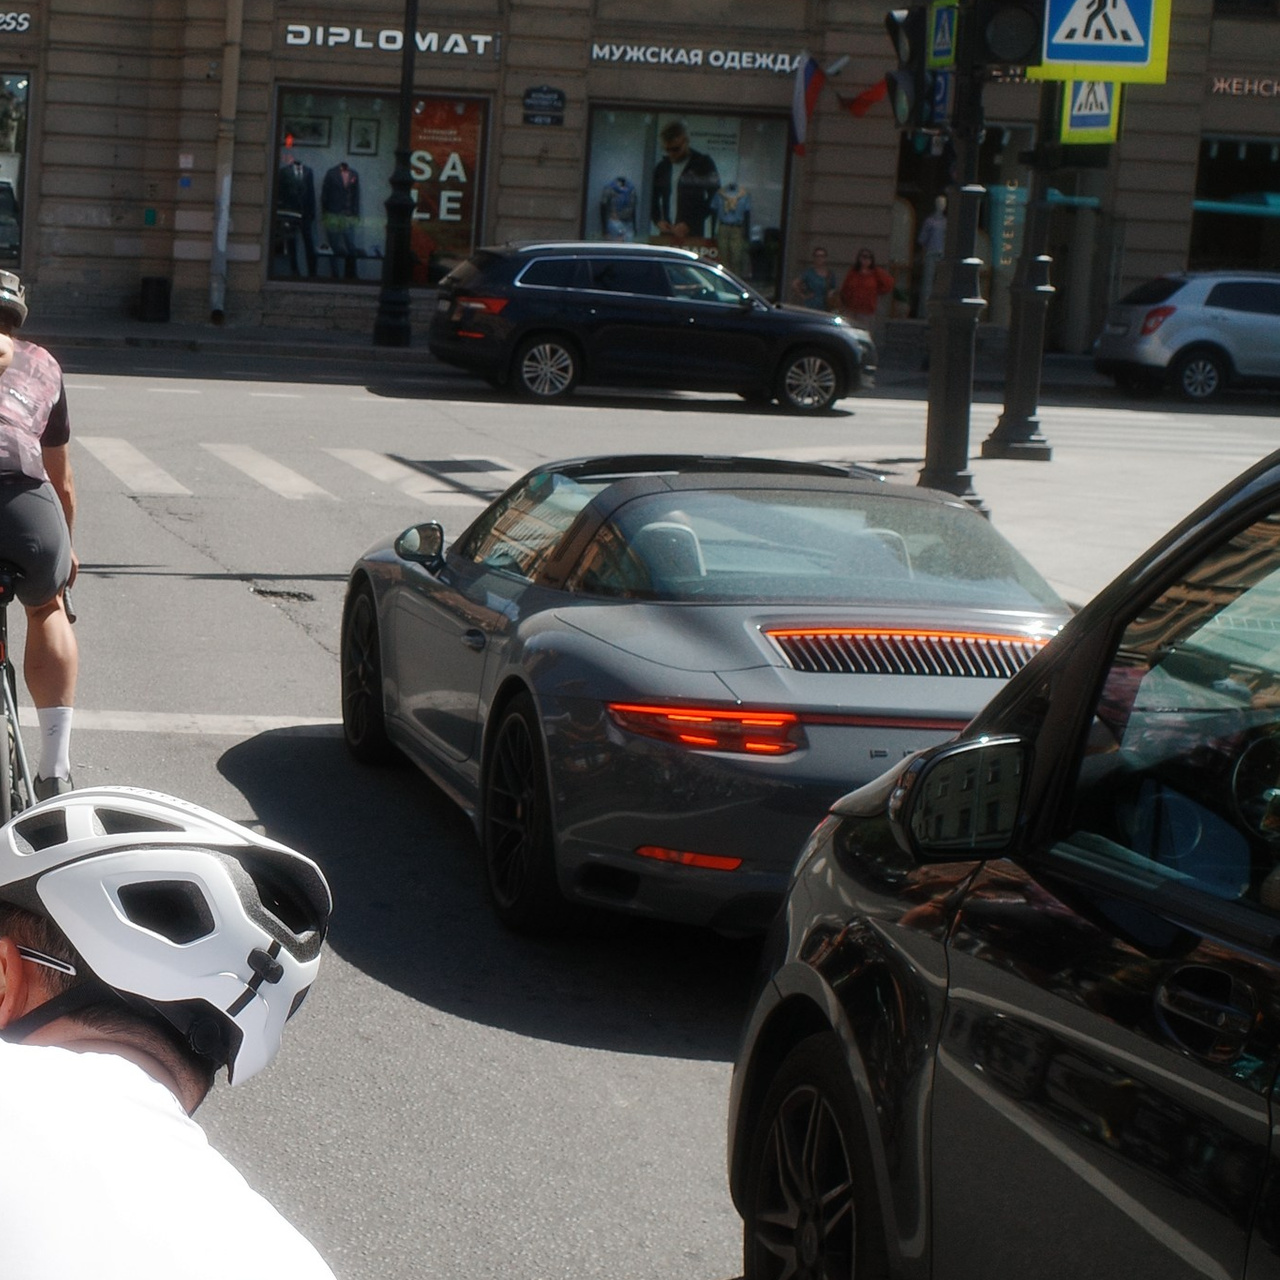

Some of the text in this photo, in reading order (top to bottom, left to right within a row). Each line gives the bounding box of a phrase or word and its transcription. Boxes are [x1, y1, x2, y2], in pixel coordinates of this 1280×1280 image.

[286, 24, 493, 56] DIPLOMAT
[592, 43, 703, 67] МУЖСКАЯ
[410, 150, 467, 183] SA
